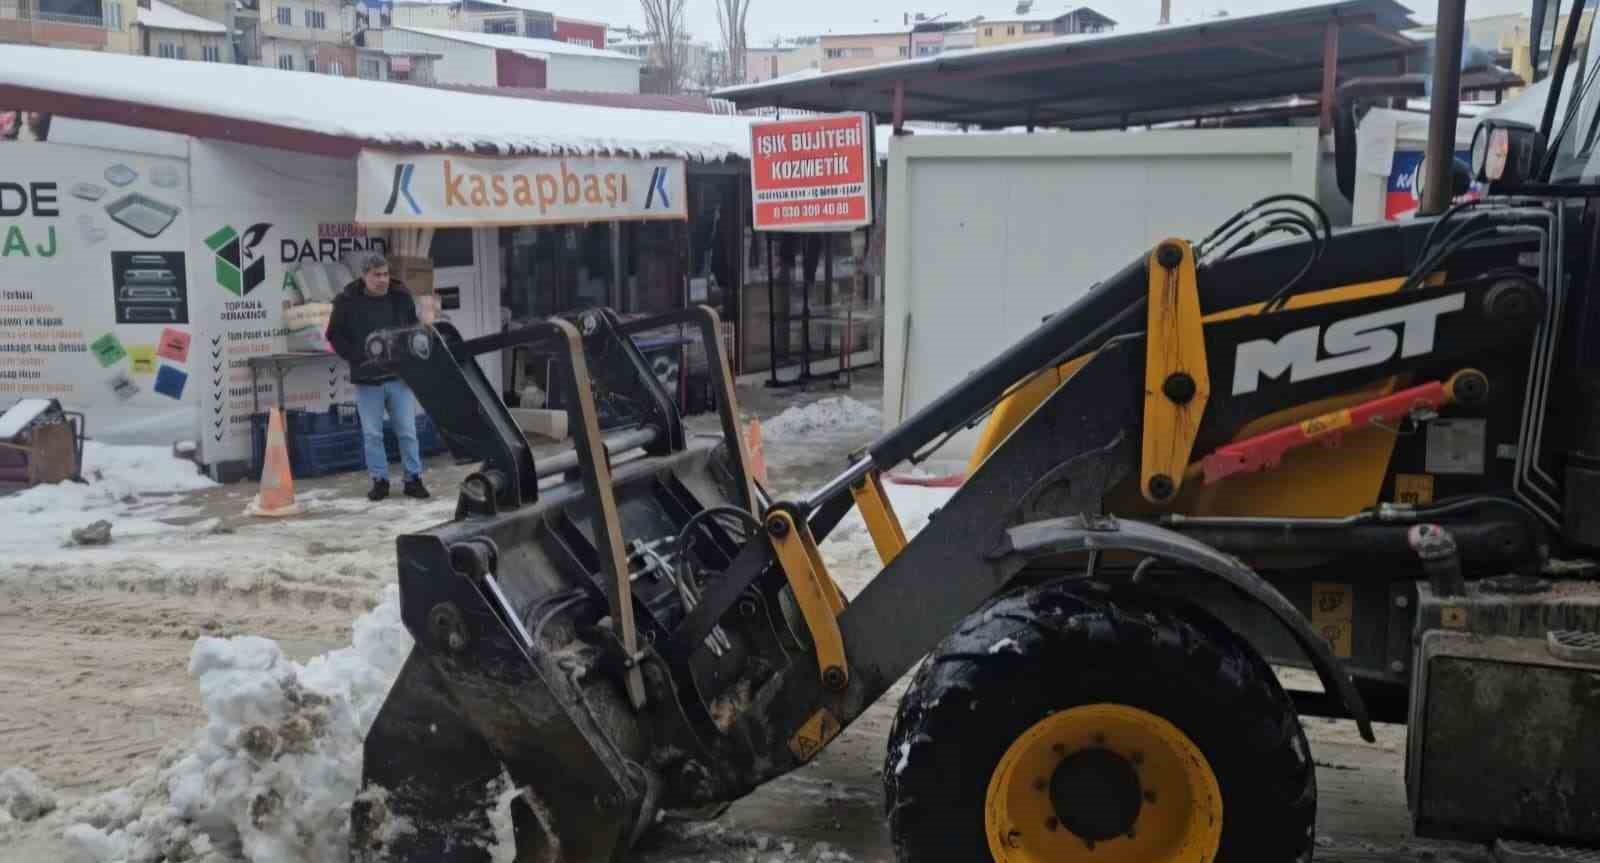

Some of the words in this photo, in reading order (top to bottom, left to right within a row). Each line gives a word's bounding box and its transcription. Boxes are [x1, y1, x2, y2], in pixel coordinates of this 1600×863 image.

[442, 159, 628, 215] kasapbaşı
[771, 152, 849, 181] KOZMETİK
[1232, 292, 1466, 396] MST
